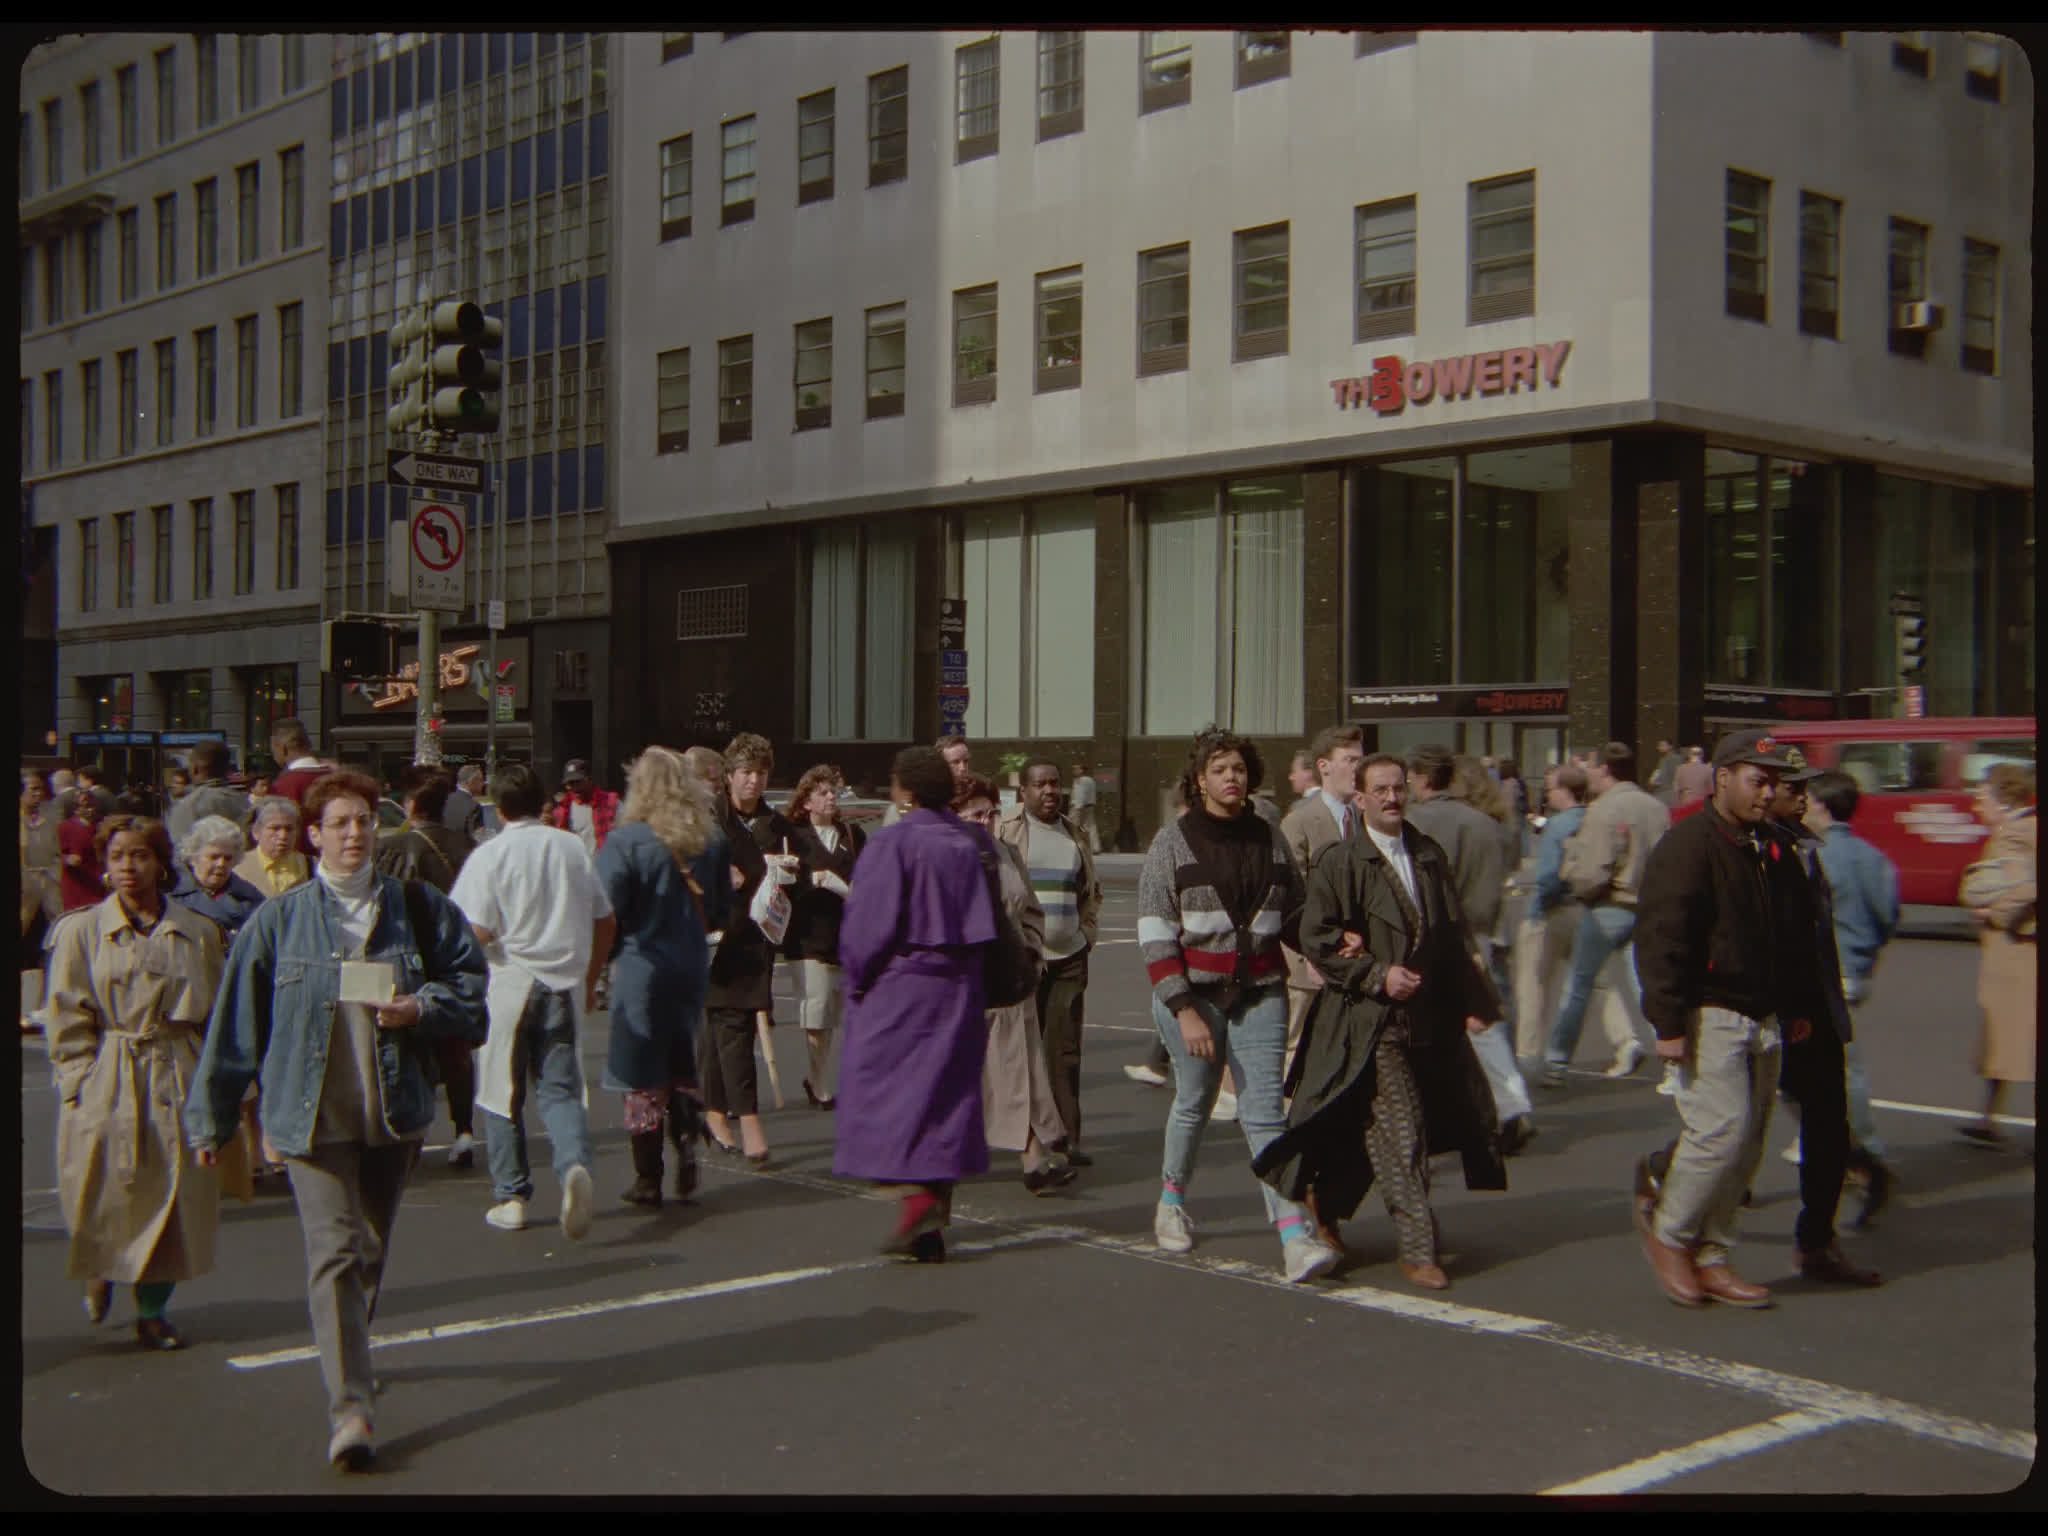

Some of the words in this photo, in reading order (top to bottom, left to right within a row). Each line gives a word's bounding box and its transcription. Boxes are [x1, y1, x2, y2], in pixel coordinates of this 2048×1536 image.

[1369, 339, 1573, 417] BOWERY
[416, 463, 443, 479] ONE
[447, 464, 475, 481] WAY
[415, 575, 425, 589] 8
[443, 576, 451, 591] 7
[943, 699, 967, 712] 495
[1490, 692, 1567, 713] BOWERY
